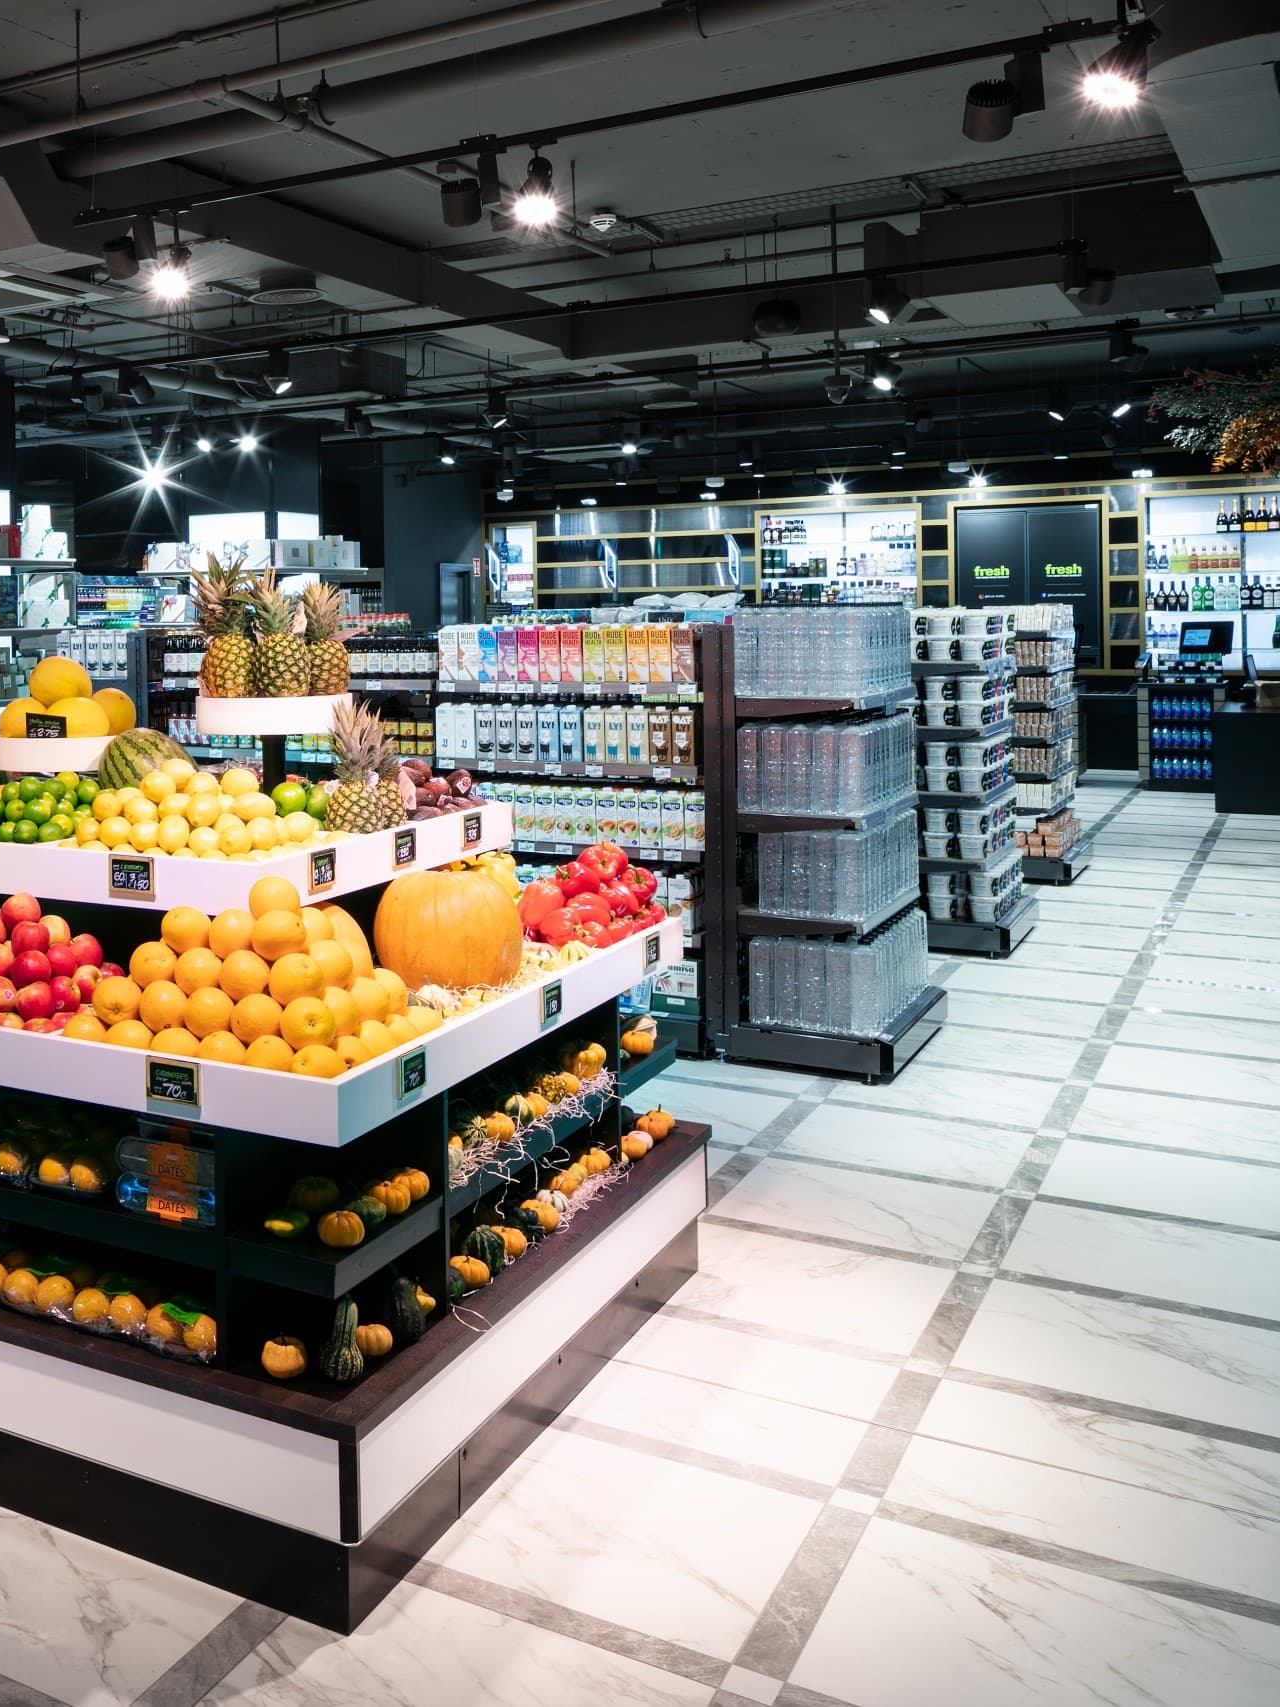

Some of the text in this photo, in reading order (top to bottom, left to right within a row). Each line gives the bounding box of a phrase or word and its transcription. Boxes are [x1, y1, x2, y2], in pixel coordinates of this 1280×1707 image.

[974, 565, 1010, 577] fresh
[1045, 563, 1082, 575] fresh
[520, 632, 535, 640] RUDE
[541, 632, 556, 640] RUDE
[563, 631, 578, 640] RUDE
[606, 631, 622, 639] RUDE
[628, 631, 644, 639] RUDE
[651, 631, 667, 639] RUDE
[674, 630, 690, 639] RUDE
[480, 720, 492, 728] LY!
[500, 720, 512, 728] LY!
[520, 721, 533, 729] LY!
[541, 721, 554, 729] LY!
[564, 722, 576, 730] LY!
[587, 722, 600, 730] LY!
[631, 723, 644, 731] LY!
[158, 1164, 186, 1178] DATES
[158, 1200, 186, 1214] DATES
